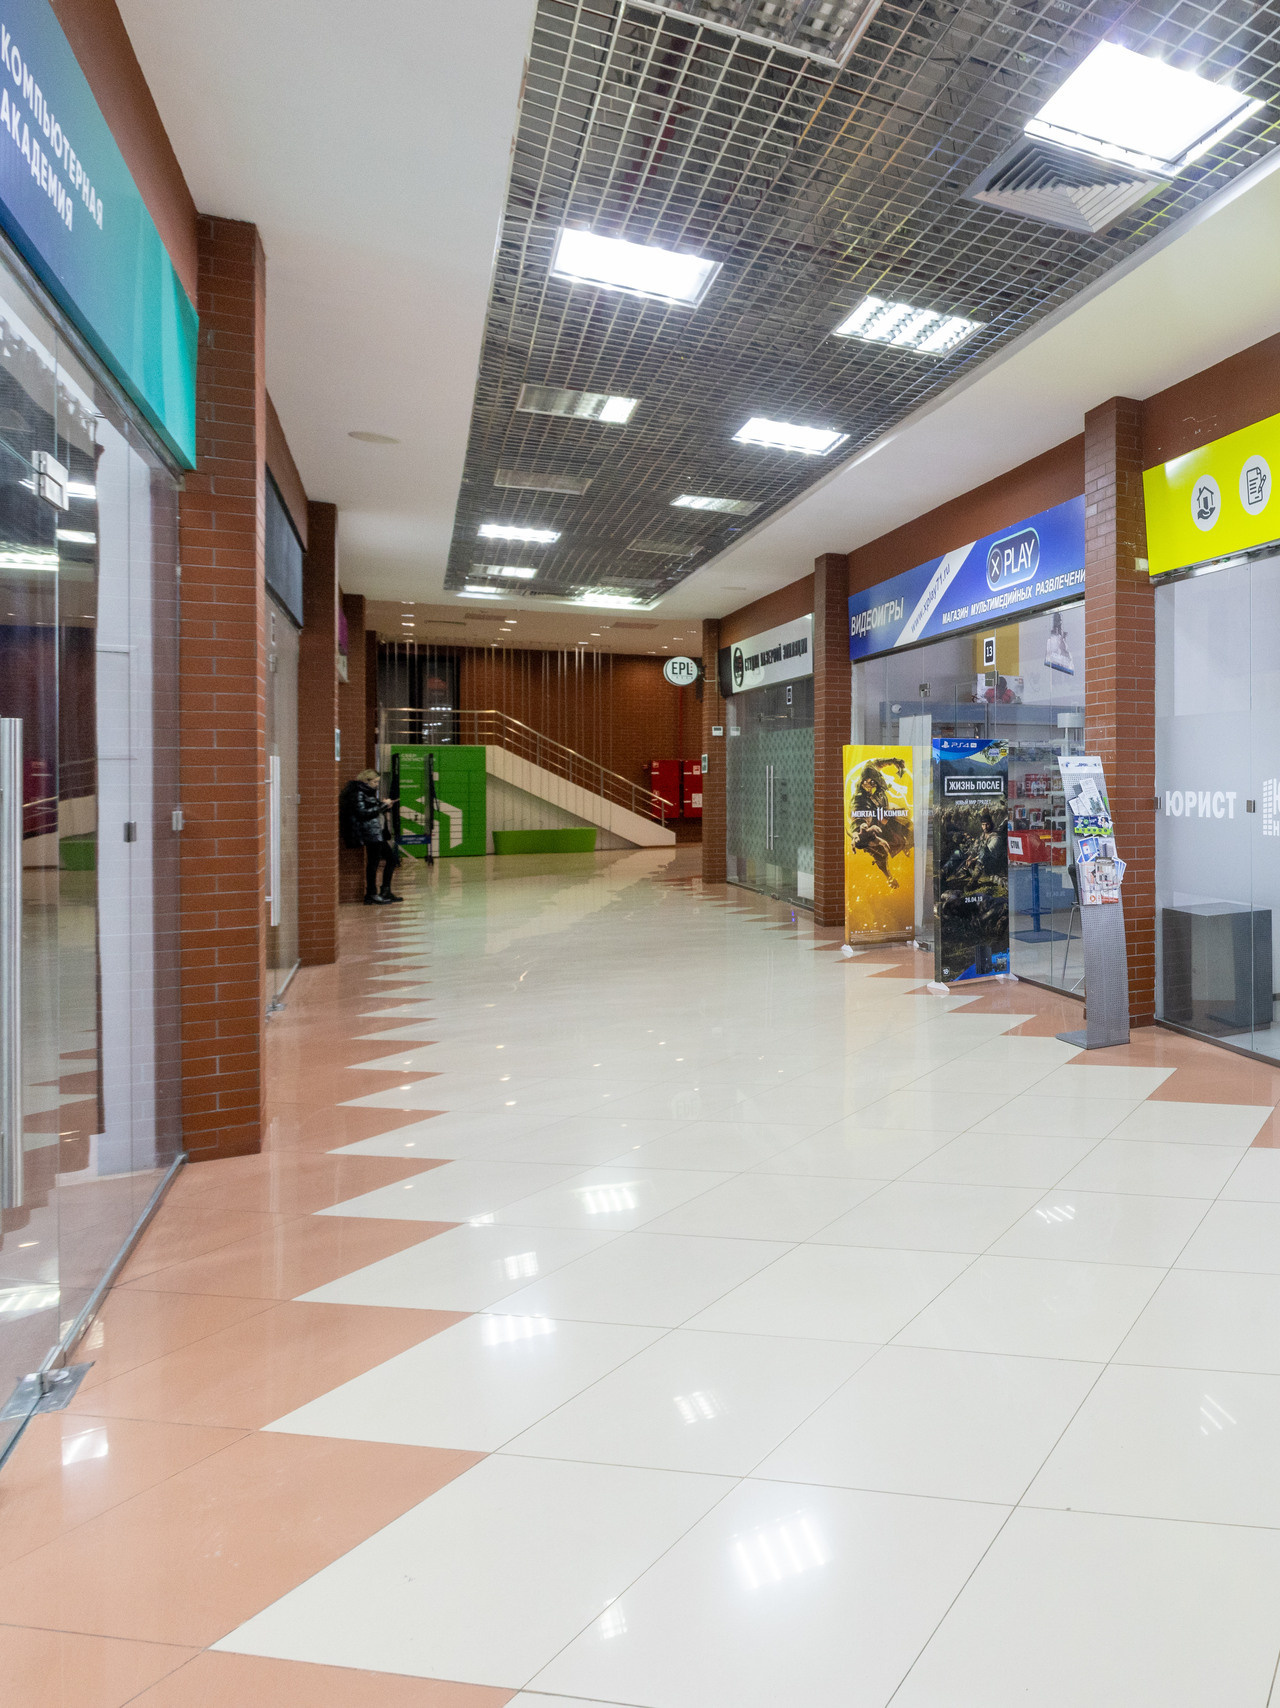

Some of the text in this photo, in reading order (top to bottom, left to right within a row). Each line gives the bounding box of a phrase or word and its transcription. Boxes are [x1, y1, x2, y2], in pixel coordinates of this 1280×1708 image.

[1, 23, 103, 230] КОМПЬЮТЕРНАЯ
[0, 87, 73, 231] АКАДЕМИЯ
[1003, 538, 1035, 577] PLAY
[851, 597, 904, 638] ВИДЕОИГРЫ
[942, 607, 969, 625] МАГАЗИН
[970, 585, 1033, 617] МУЛЬТИМЕДИЙНЫХ
[986, 646, 993, 657] 13
[671, 662, 693, 675] EPL
[949, 781, 1000, 790] ЖИЗНЬ ПОСЛЕ
[851, 809, 876, 817] MORTAL
[884, 809, 909, 817] KOMBAT
[1165, 791, 1237, 819] ЮРИСТ
